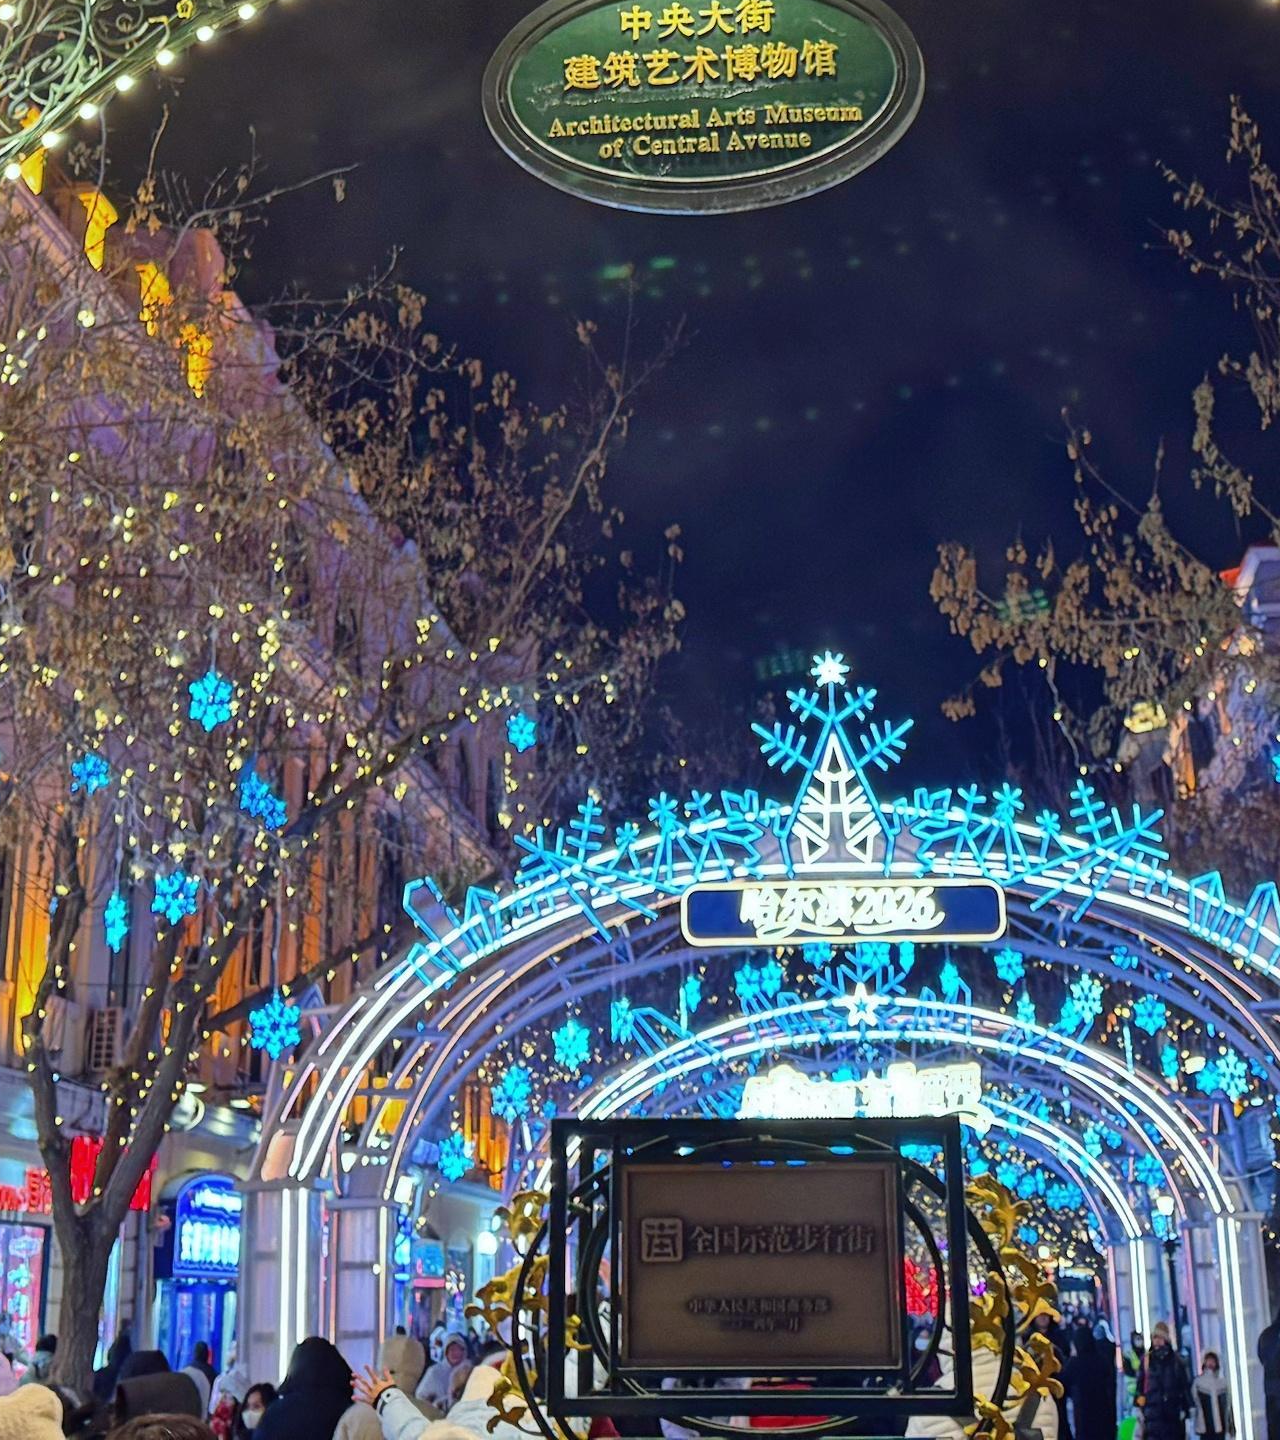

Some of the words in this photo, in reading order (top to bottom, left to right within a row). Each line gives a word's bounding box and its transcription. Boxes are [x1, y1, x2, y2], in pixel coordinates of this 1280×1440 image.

[563, 40, 839, 92] 建筑艺术博物馆
[548, 109, 700, 139] Architectural
[706, 110, 757, 130] Arts
[764, 104, 864, 126] Museum
[599, 137, 623, 159] of
[627, 133, 720, 157] Central
[726, 131, 812, 151] Avenue
[689, 1224, 874, 1255] 全国示范步行街
